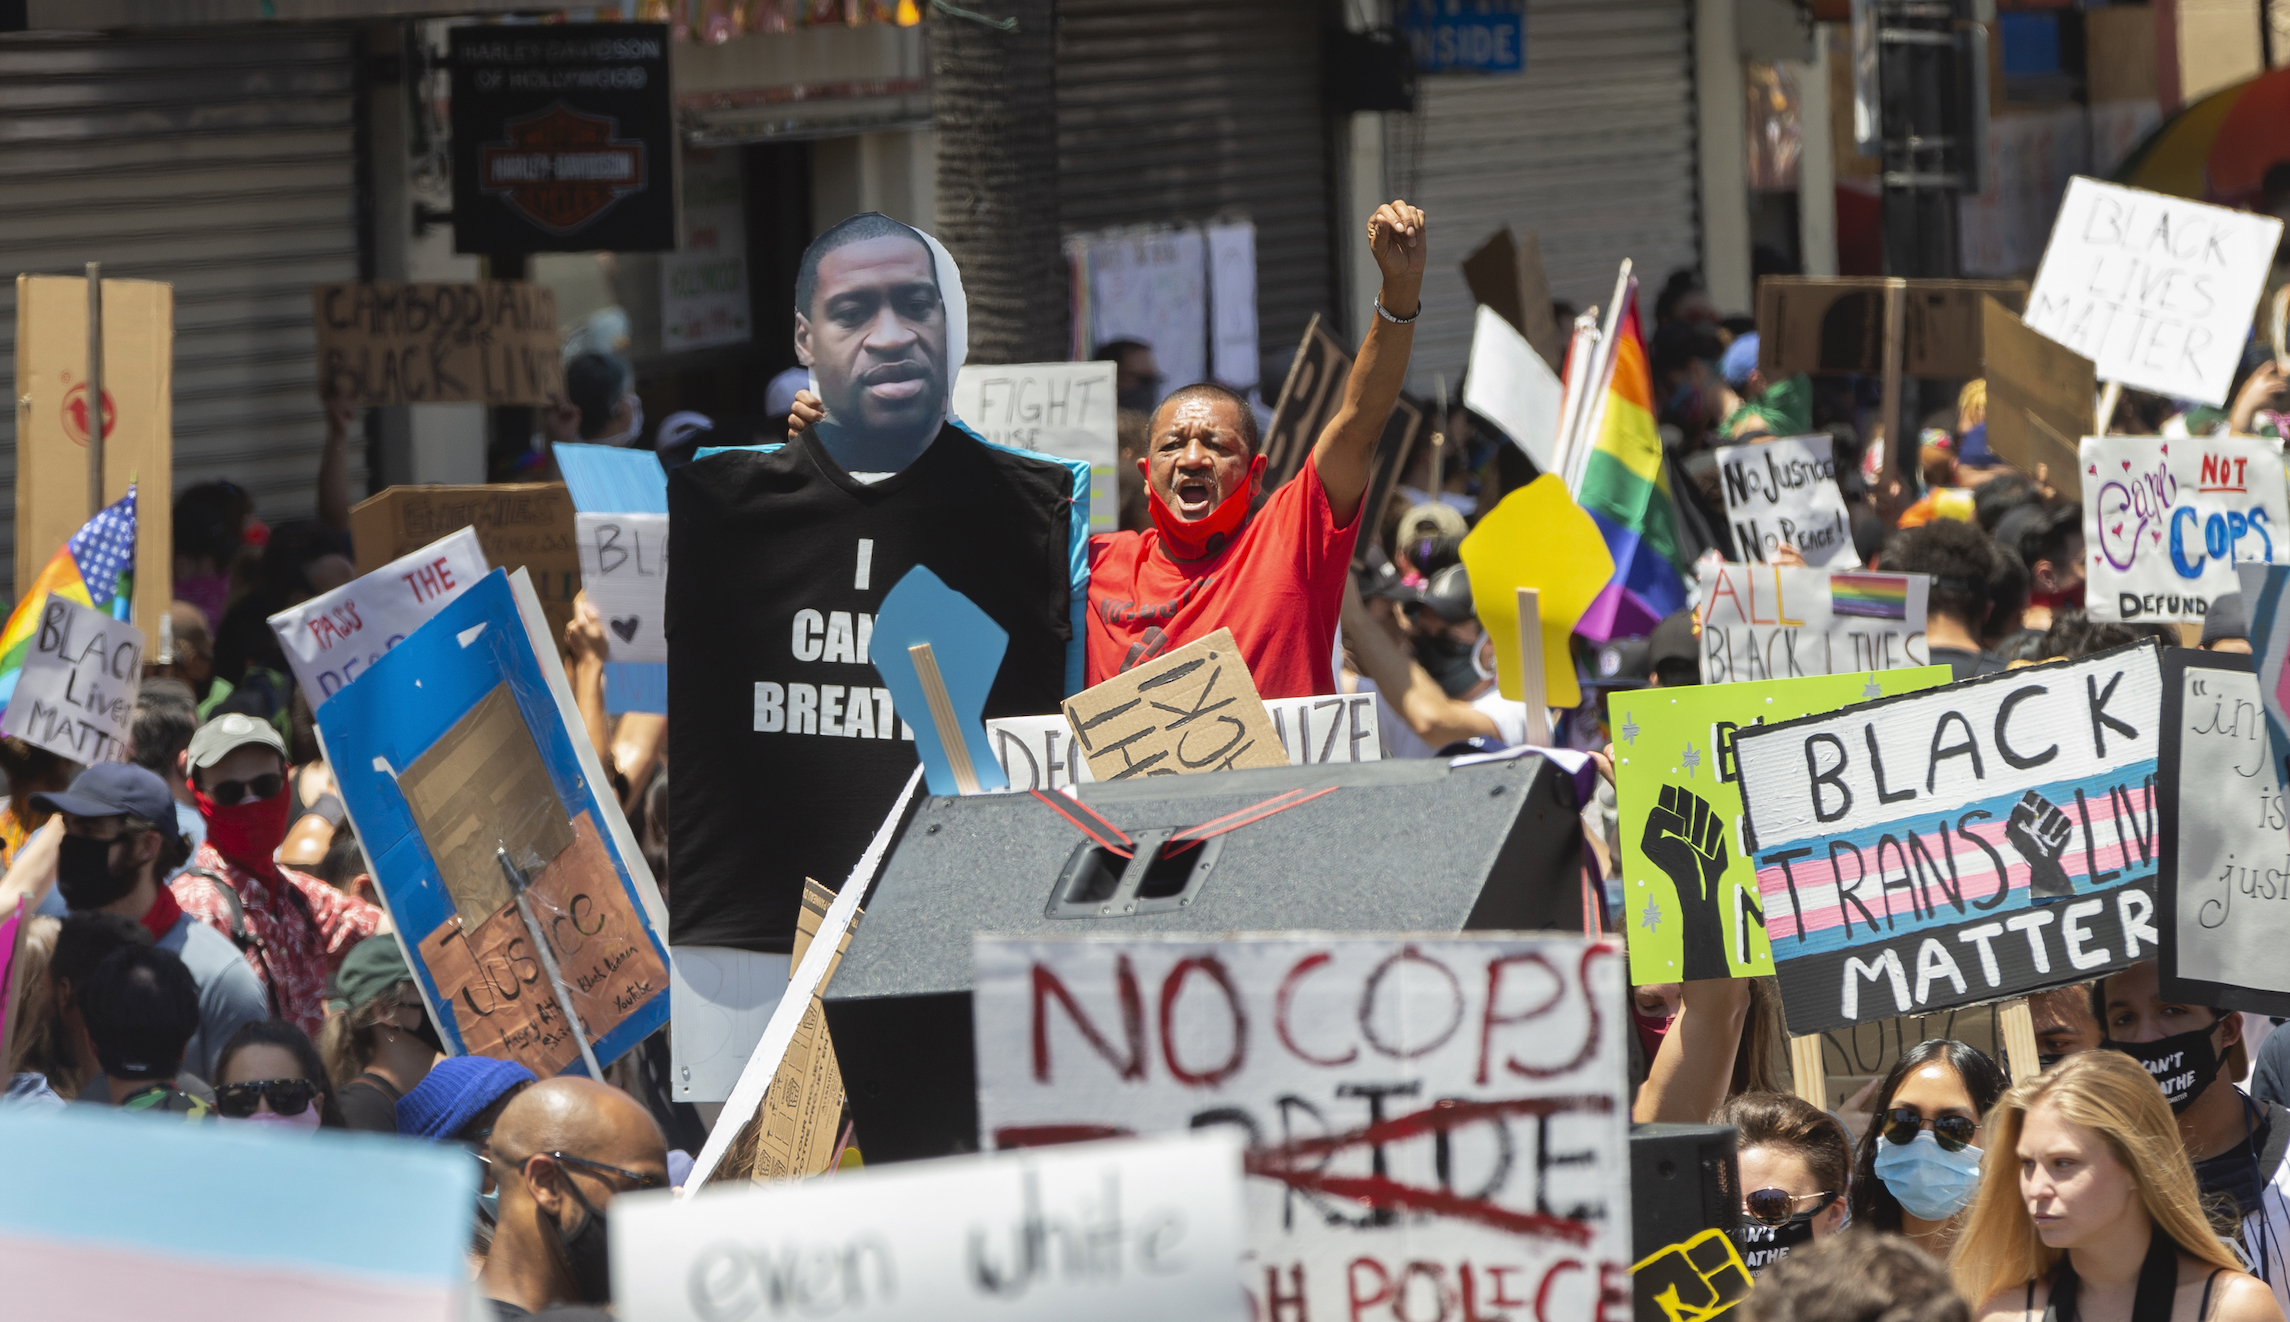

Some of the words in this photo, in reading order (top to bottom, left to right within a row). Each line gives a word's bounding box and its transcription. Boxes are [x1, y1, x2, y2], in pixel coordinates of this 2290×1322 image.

[2083, 193, 2235, 266] BLACK
[2089, 257, 2216, 320] LIVES
[2031, 291, 2213, 380] MATTER
[322, 347, 470, 402] BLACK
[978, 376, 1108, 428] FIGHT
[2200, 452, 2248, 487] NOT
[854, 538, 874, 590] I
[2170, 505, 2273, 579] COPS
[307, 598, 363, 652] PASS
[403, 556, 457, 606] THE
[1704, 567, 1806, 627] ALL
[2119, 592, 2209, 621] DEFUND
[38, 602, 144, 686] BLACK
[1704, 624, 1805, 685] BLACK
[753, 681, 915, 741] BREAT
[1804, 671, 2140, 823] BLACK
[1761, 809, 2010, 944] TRANS
[2074, 772, 2160, 886] LIV
[1841, 888, 2160, 1022] MATTER
[1029, 952, 1250, 1091] NO
[1274, 943, 1615, 1085] COPS
[795, 1119, 807, 1163] YOUR
